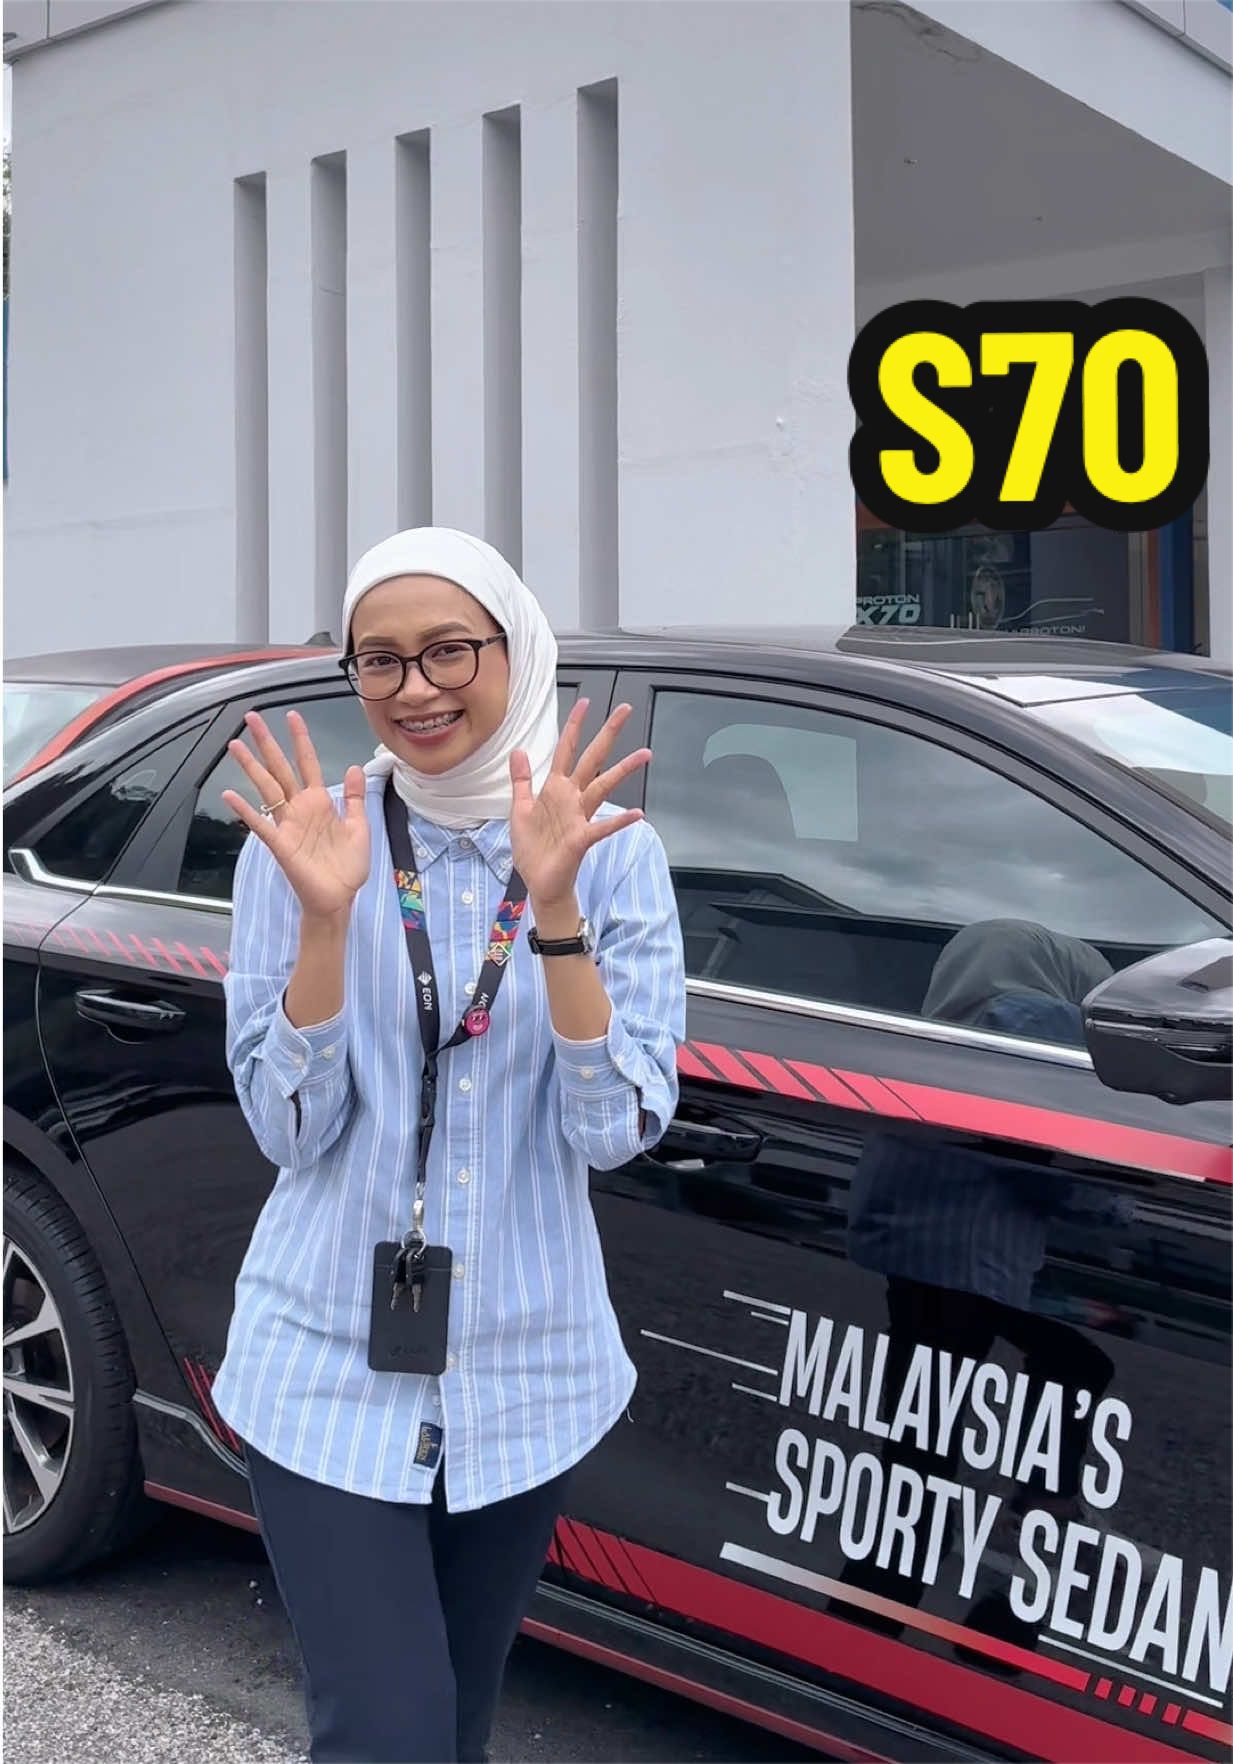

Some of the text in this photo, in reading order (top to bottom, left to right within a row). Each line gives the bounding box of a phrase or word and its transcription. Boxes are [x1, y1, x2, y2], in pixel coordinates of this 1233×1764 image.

[857, 603, 921, 625] X70
[422, 987, 433, 1011] EON
[779, 1309, 1132, 1509] MALAYSIA'S
[766, 1428, 1233, 1693] SPORTY SEDAN
